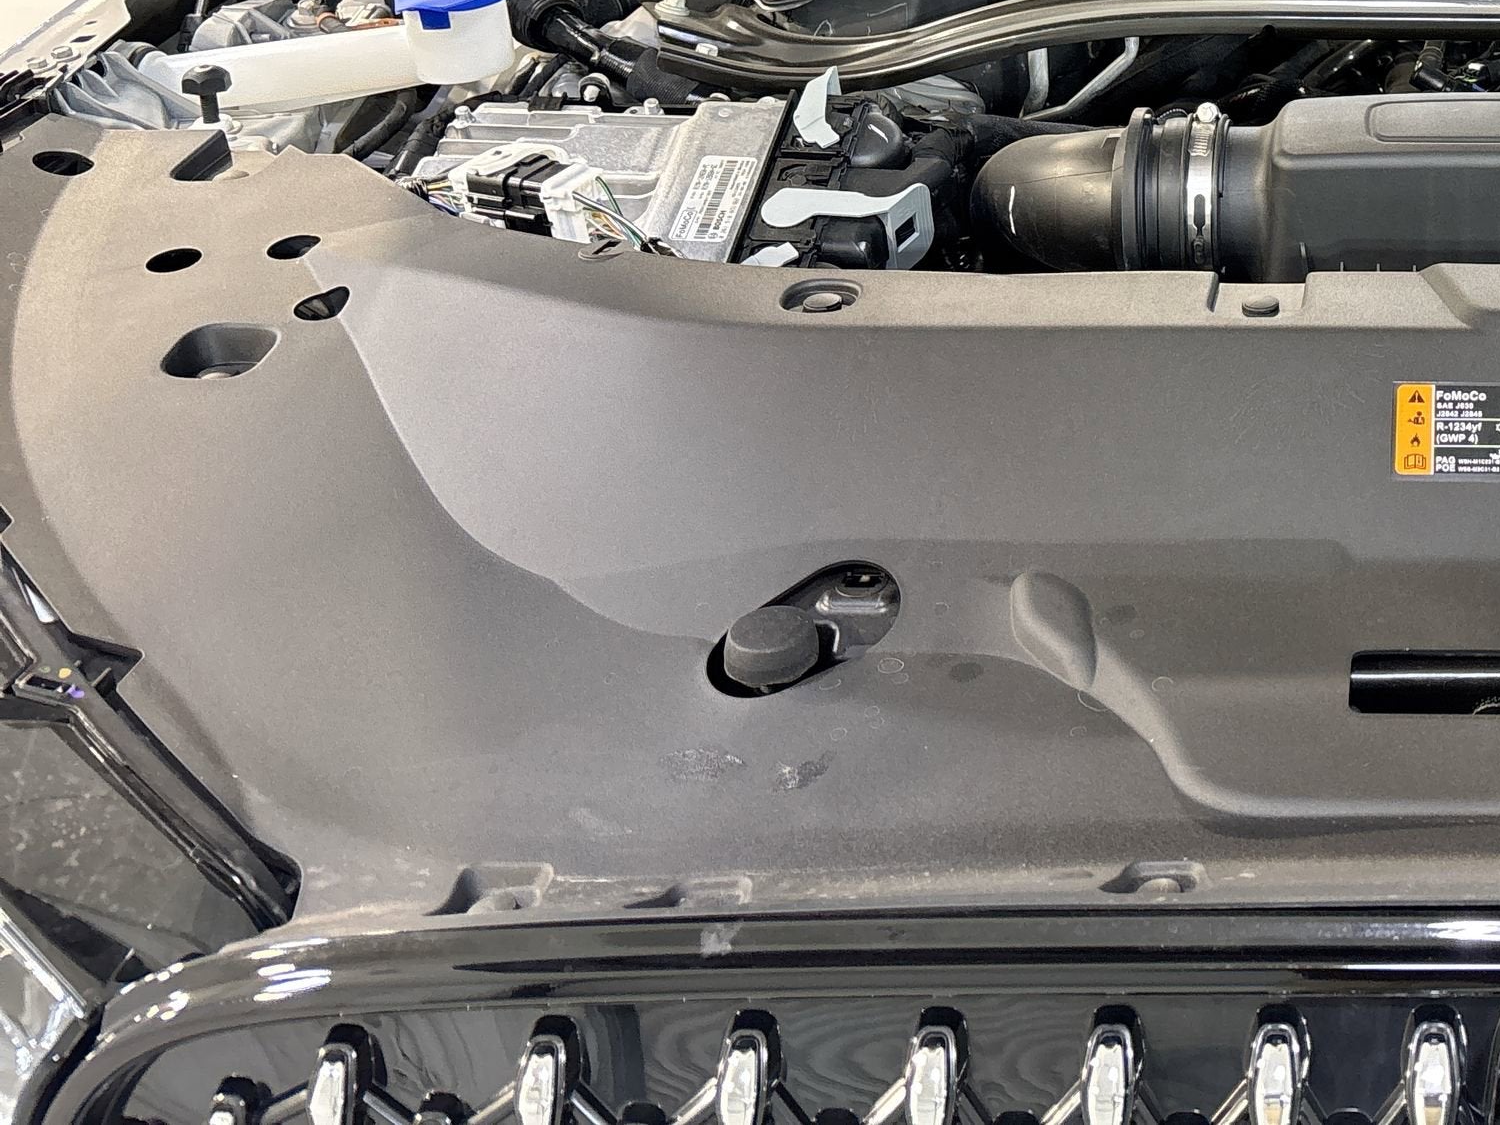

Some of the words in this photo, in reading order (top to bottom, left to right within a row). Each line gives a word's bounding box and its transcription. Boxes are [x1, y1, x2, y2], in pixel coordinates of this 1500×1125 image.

[675, 211, 694, 238] FoMoCo
[712, 210, 726, 230] BOSCH
[1436, 390, 1487, 401] FoMoCo
[1436, 402, 1454, 410] SAE
[1436, 422, 1482, 433] R-1234yf
[1436, 433, 1466, 445] (GWP
[1467, 433, 1479, 445] 4)
[1435, 456, 1455, 464] PAG
[1435, 463, 1456, 472] POE
